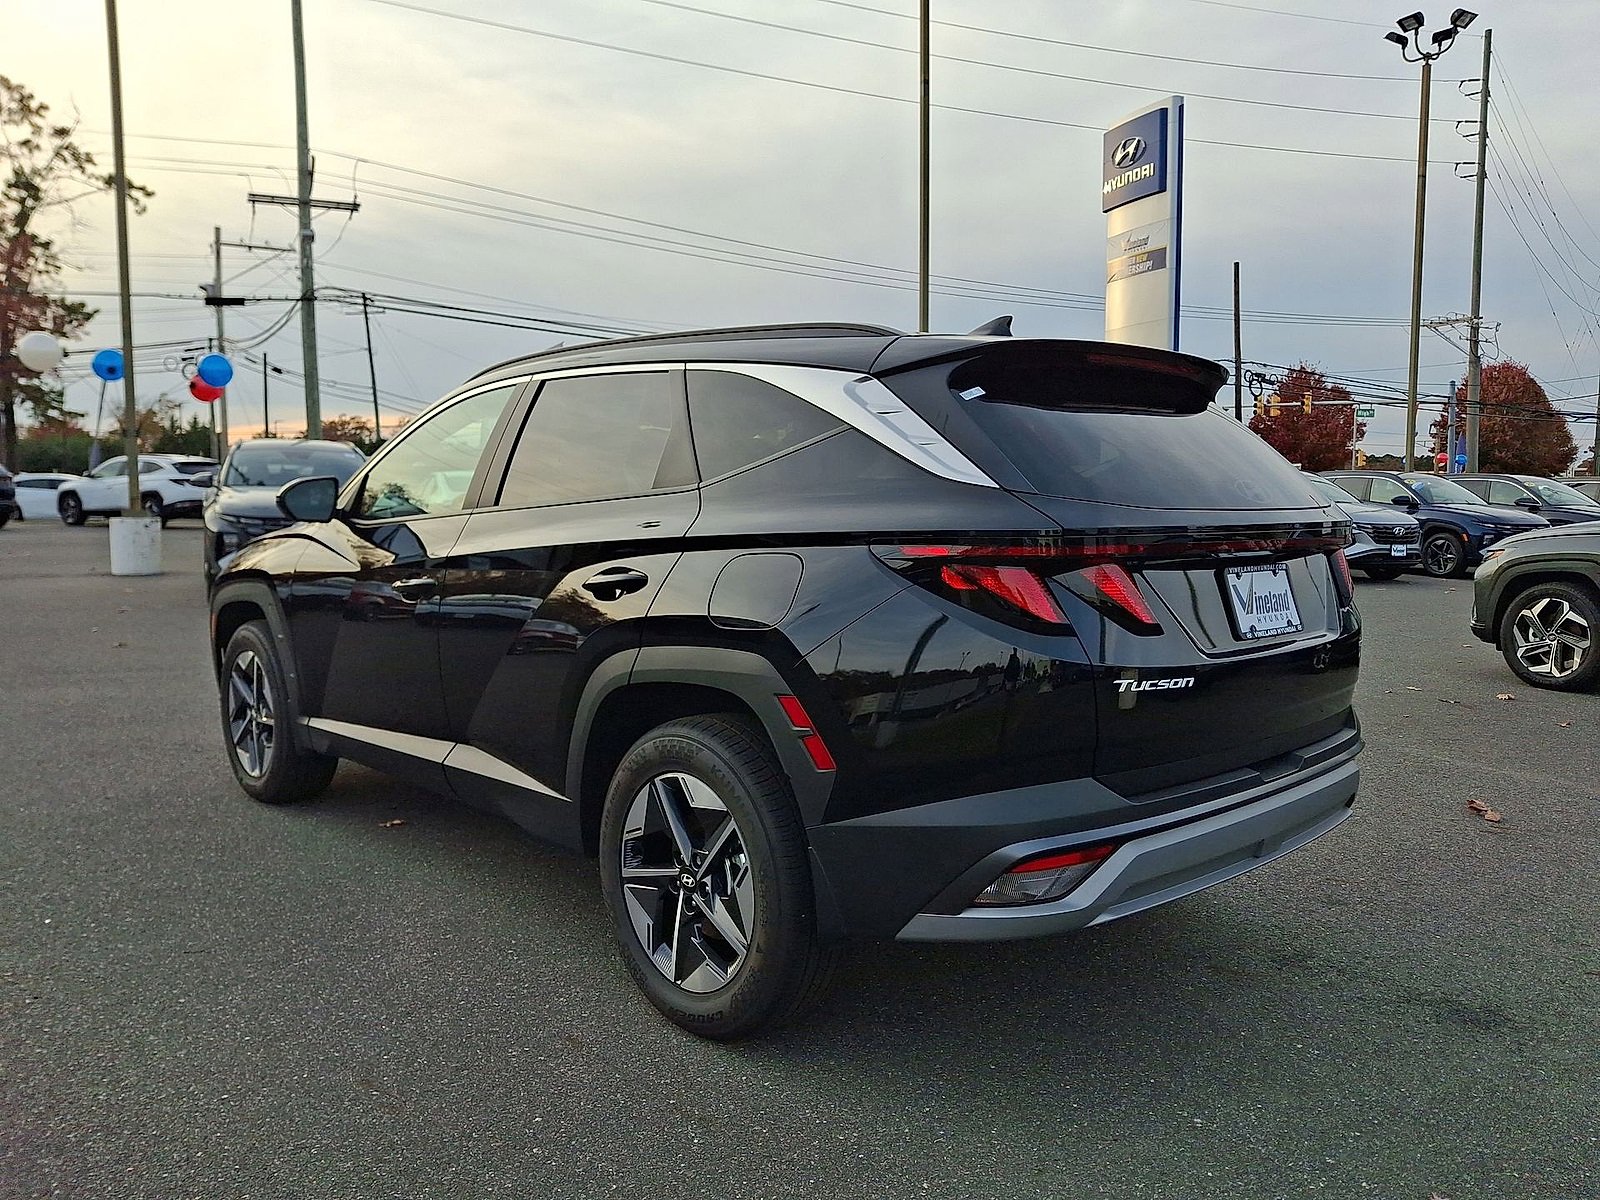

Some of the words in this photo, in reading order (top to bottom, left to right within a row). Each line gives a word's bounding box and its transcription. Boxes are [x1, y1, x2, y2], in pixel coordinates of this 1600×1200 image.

[1103, 163, 1155, 194] HYUNDAI
[1232, 573, 1291, 615] Vineland
[1256, 612, 1294, 624] HYUNDAI
